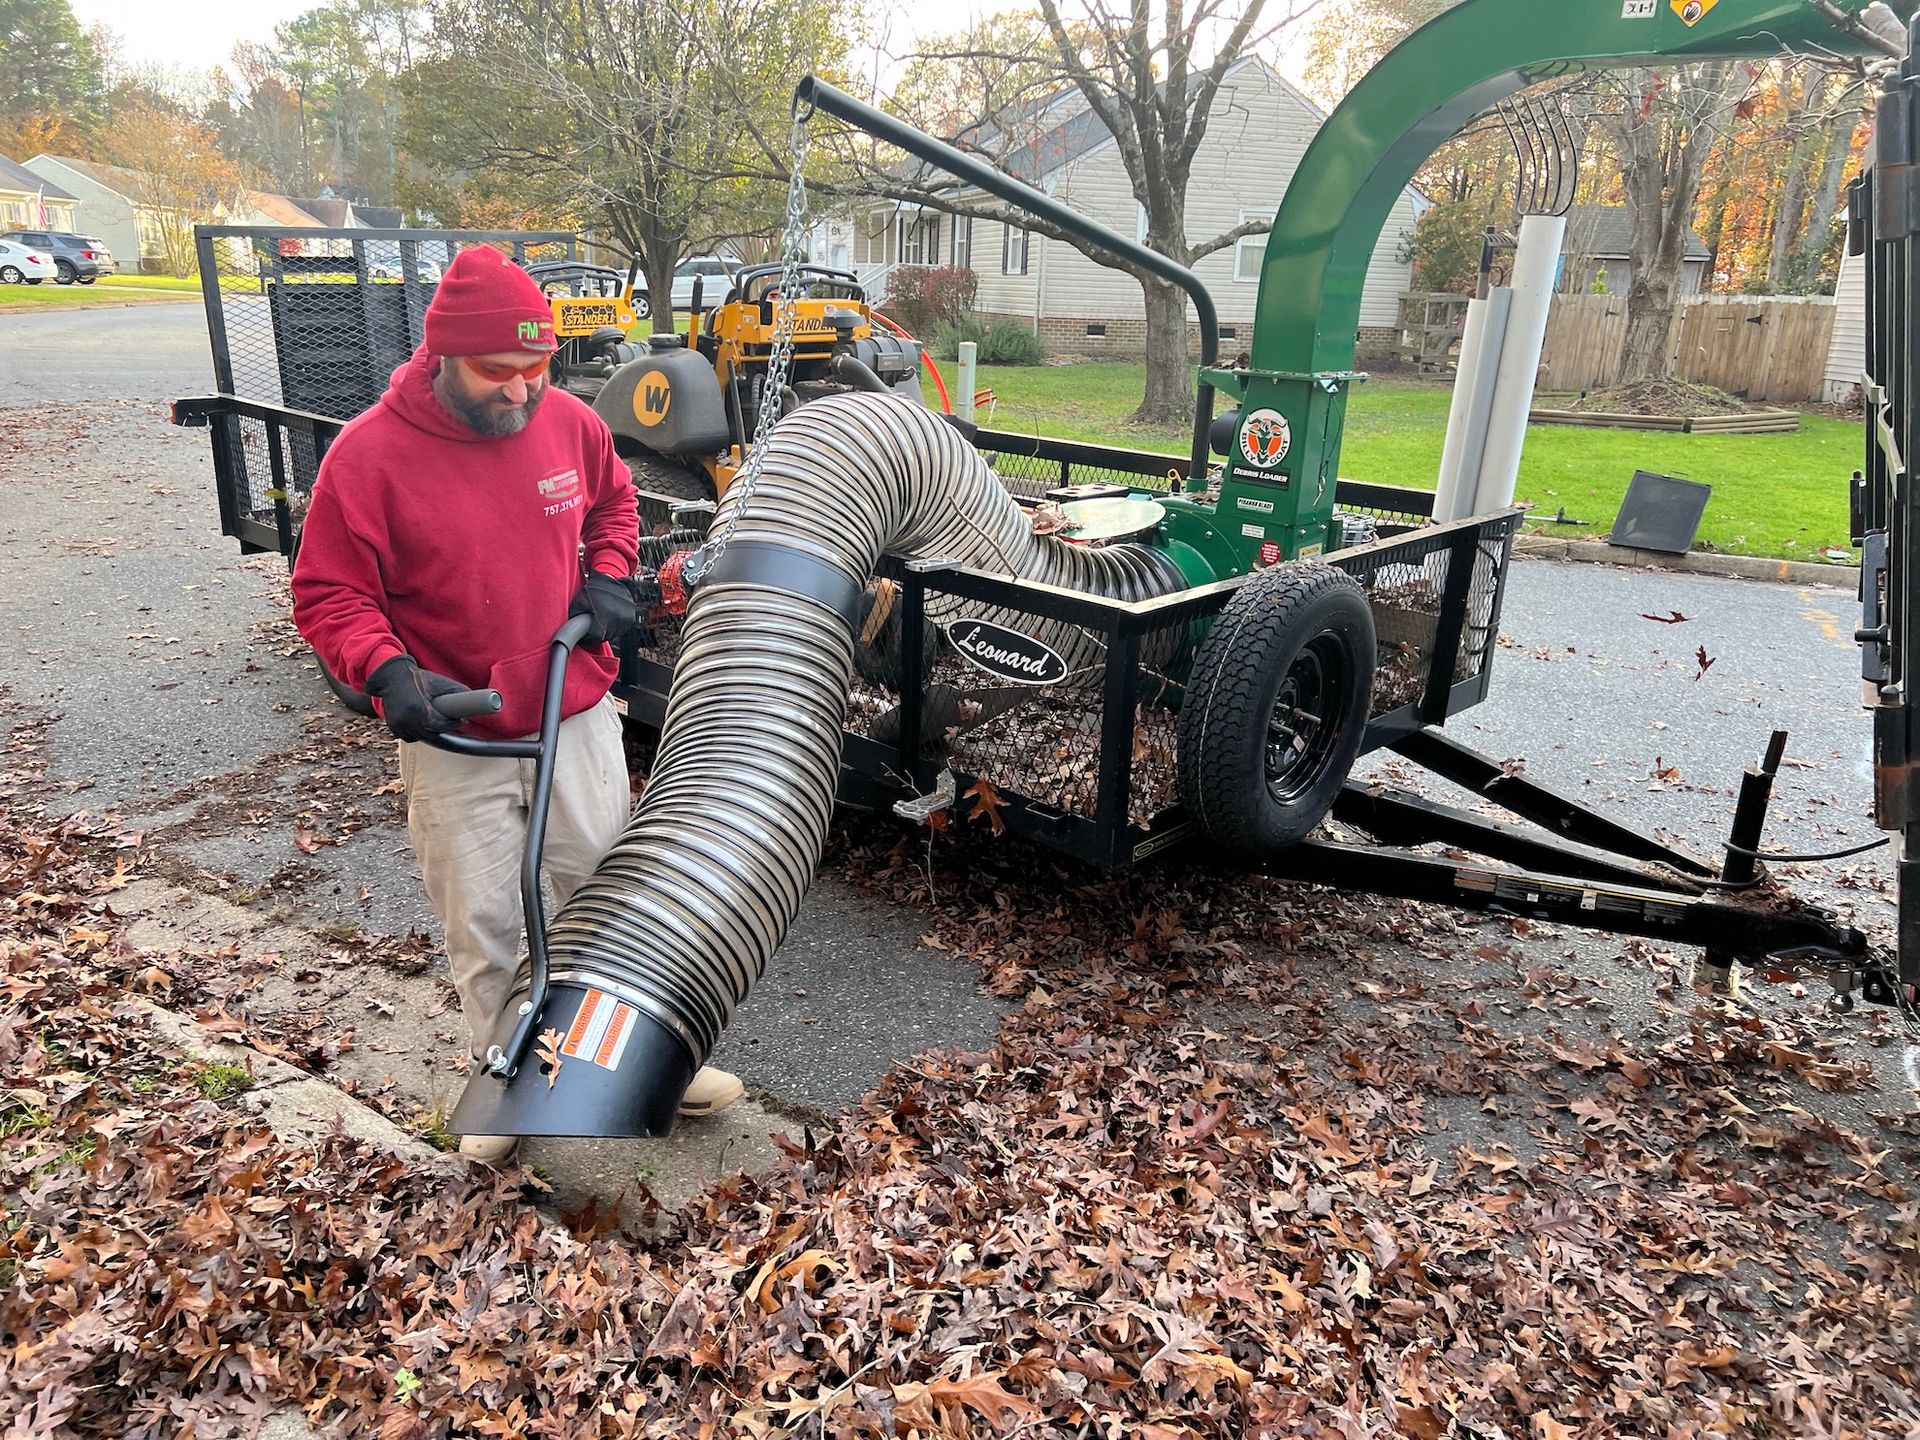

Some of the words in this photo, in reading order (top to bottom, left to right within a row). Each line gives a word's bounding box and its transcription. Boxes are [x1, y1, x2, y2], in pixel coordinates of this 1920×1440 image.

[518, 321, 538, 340] FM
[646, 385, 670, 413] W
[1241, 432, 1256, 461] BILLY
[1270, 440, 1288, 464] GOAT
[1259, 472, 1288, 483] LOADER
[958, 625, 1049, 677] Leonard
[574, 996, 597, 1034] WARNING
[604, 1008, 626, 1048] WARNING
